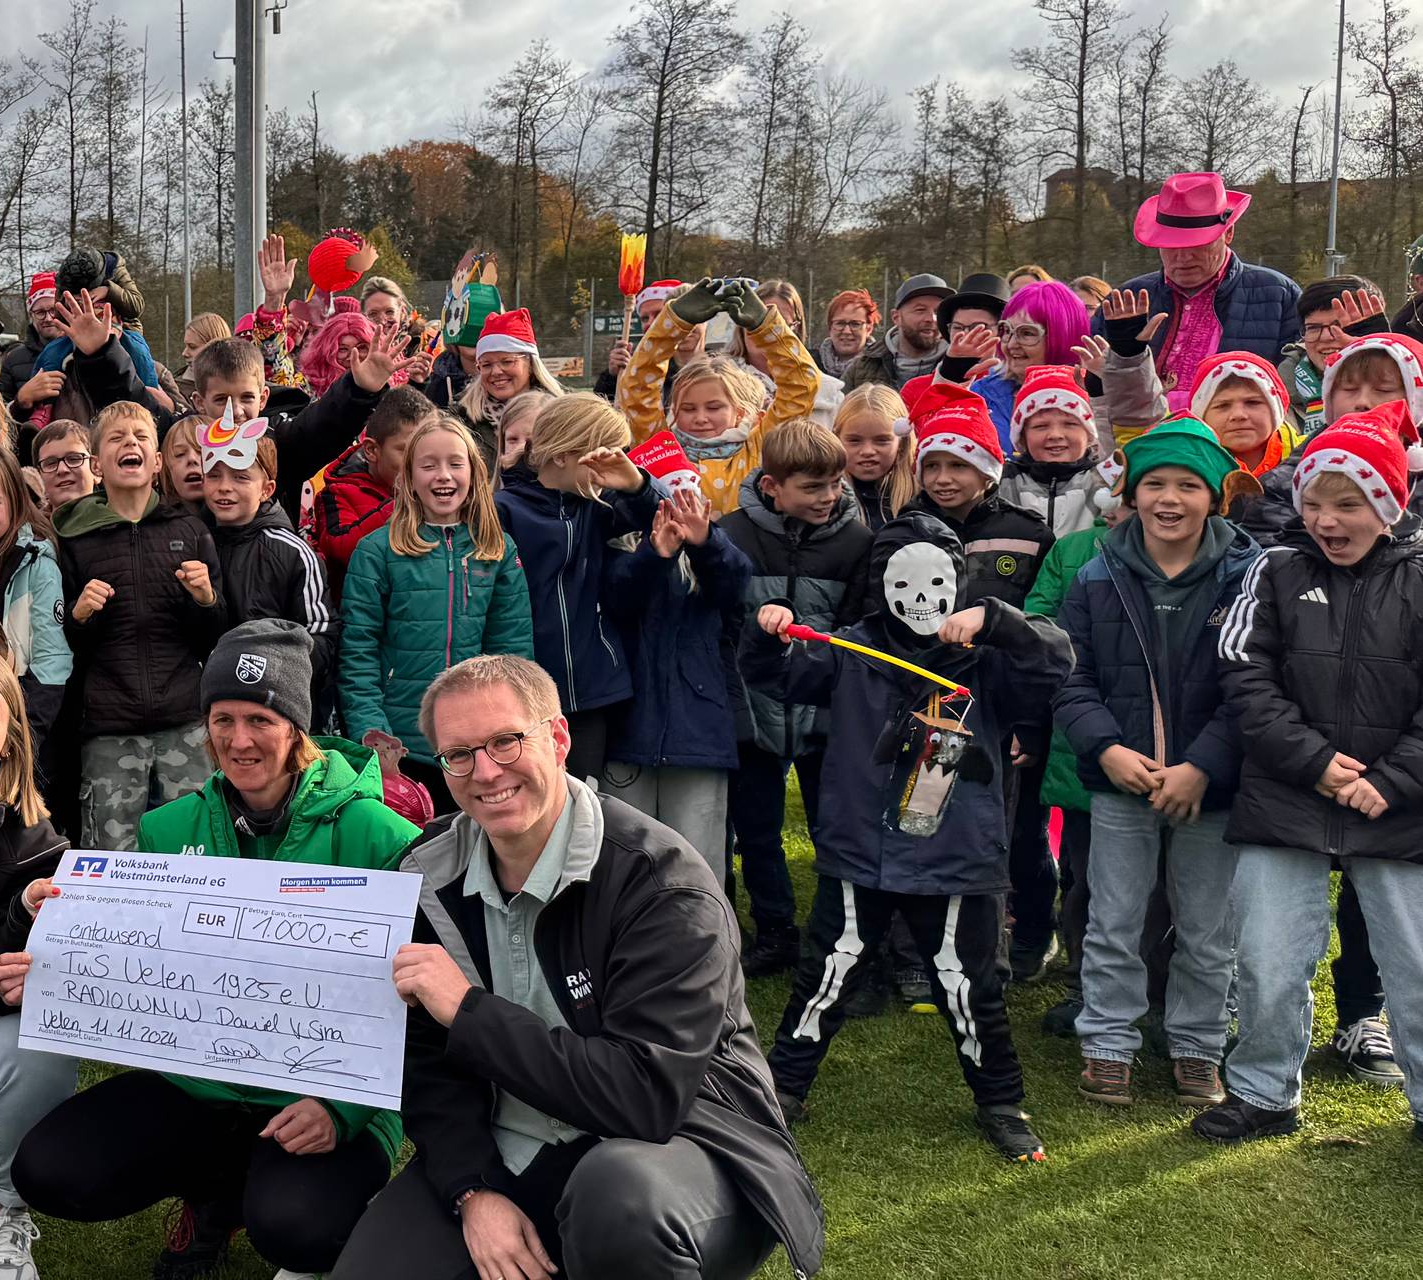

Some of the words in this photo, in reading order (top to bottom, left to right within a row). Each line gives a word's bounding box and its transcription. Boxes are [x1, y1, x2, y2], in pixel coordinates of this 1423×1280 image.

[115, 858, 170, 871] Volksbank
[110, 870, 207, 886] Westmünsterland
[209, 876, 226, 887] eG
[281, 878, 310, 887] Morgen
[311, 878, 330, 886] kann
[331, 877, 366, 886] kommen.
[61, 893, 85, 901] Zahlen
[97, 896, 120, 905] gegen
[121, 897, 144, 906] diesen
[145, 899, 173, 909] Scheck
[197, 913, 226, 927] EUR
[45, 936, 63, 946] Betrag
[70, 939, 104, 950] Buchstaben
[69, 921, 162, 949] eintausend
[61, 951, 110, 978] TuS
[212, 972, 282, 999] 1925
[41, 989, 55, 998] von
[570, 981, 593, 1000] WM
[63, 980, 124, 1009] RADIO
[217, 1007, 280, 1034] Daniel
[308, 1020, 345, 1043] Sina
